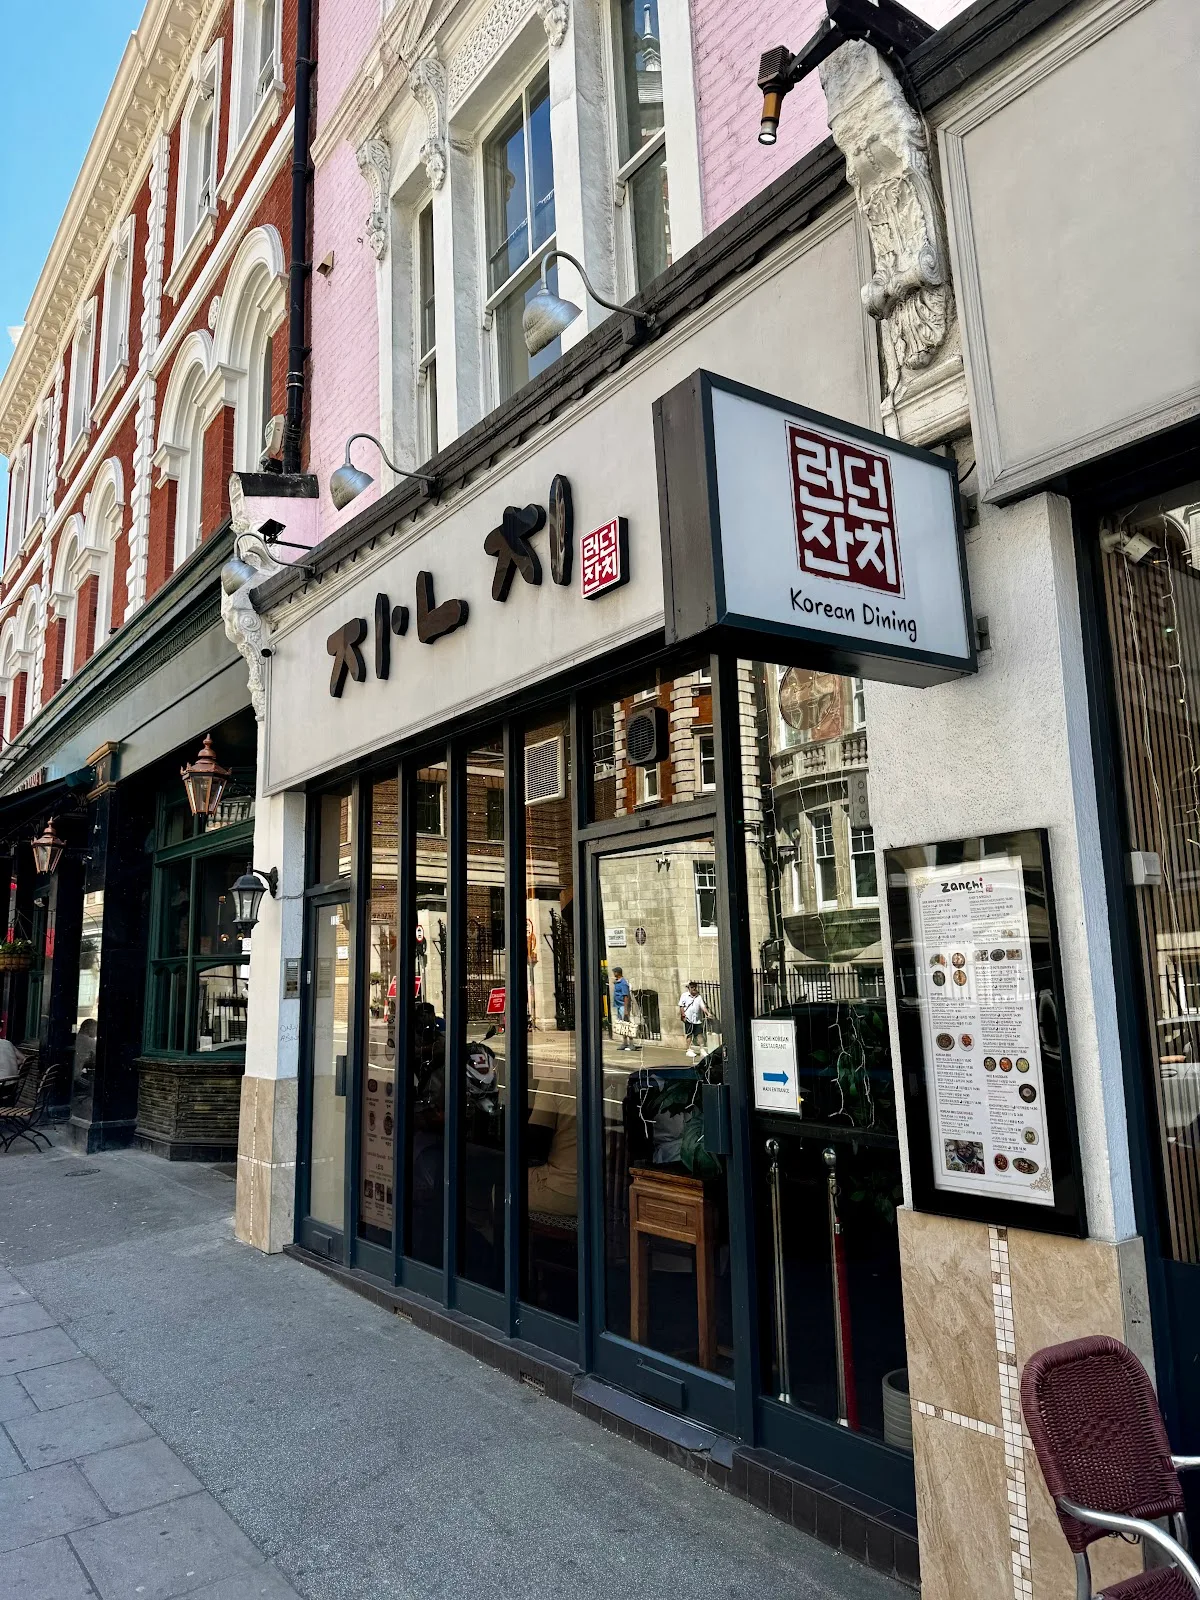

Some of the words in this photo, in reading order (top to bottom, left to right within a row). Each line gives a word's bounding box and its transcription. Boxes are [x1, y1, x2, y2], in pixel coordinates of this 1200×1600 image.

[795, 436, 889, 523] 런던
[583, 523, 616, 568] 런던
[584, 551, 617, 592] 잔치
[801, 510, 897, 585] 잔치
[790, 587, 855, 622] Korean
[863, 603, 917, 643] Dining
